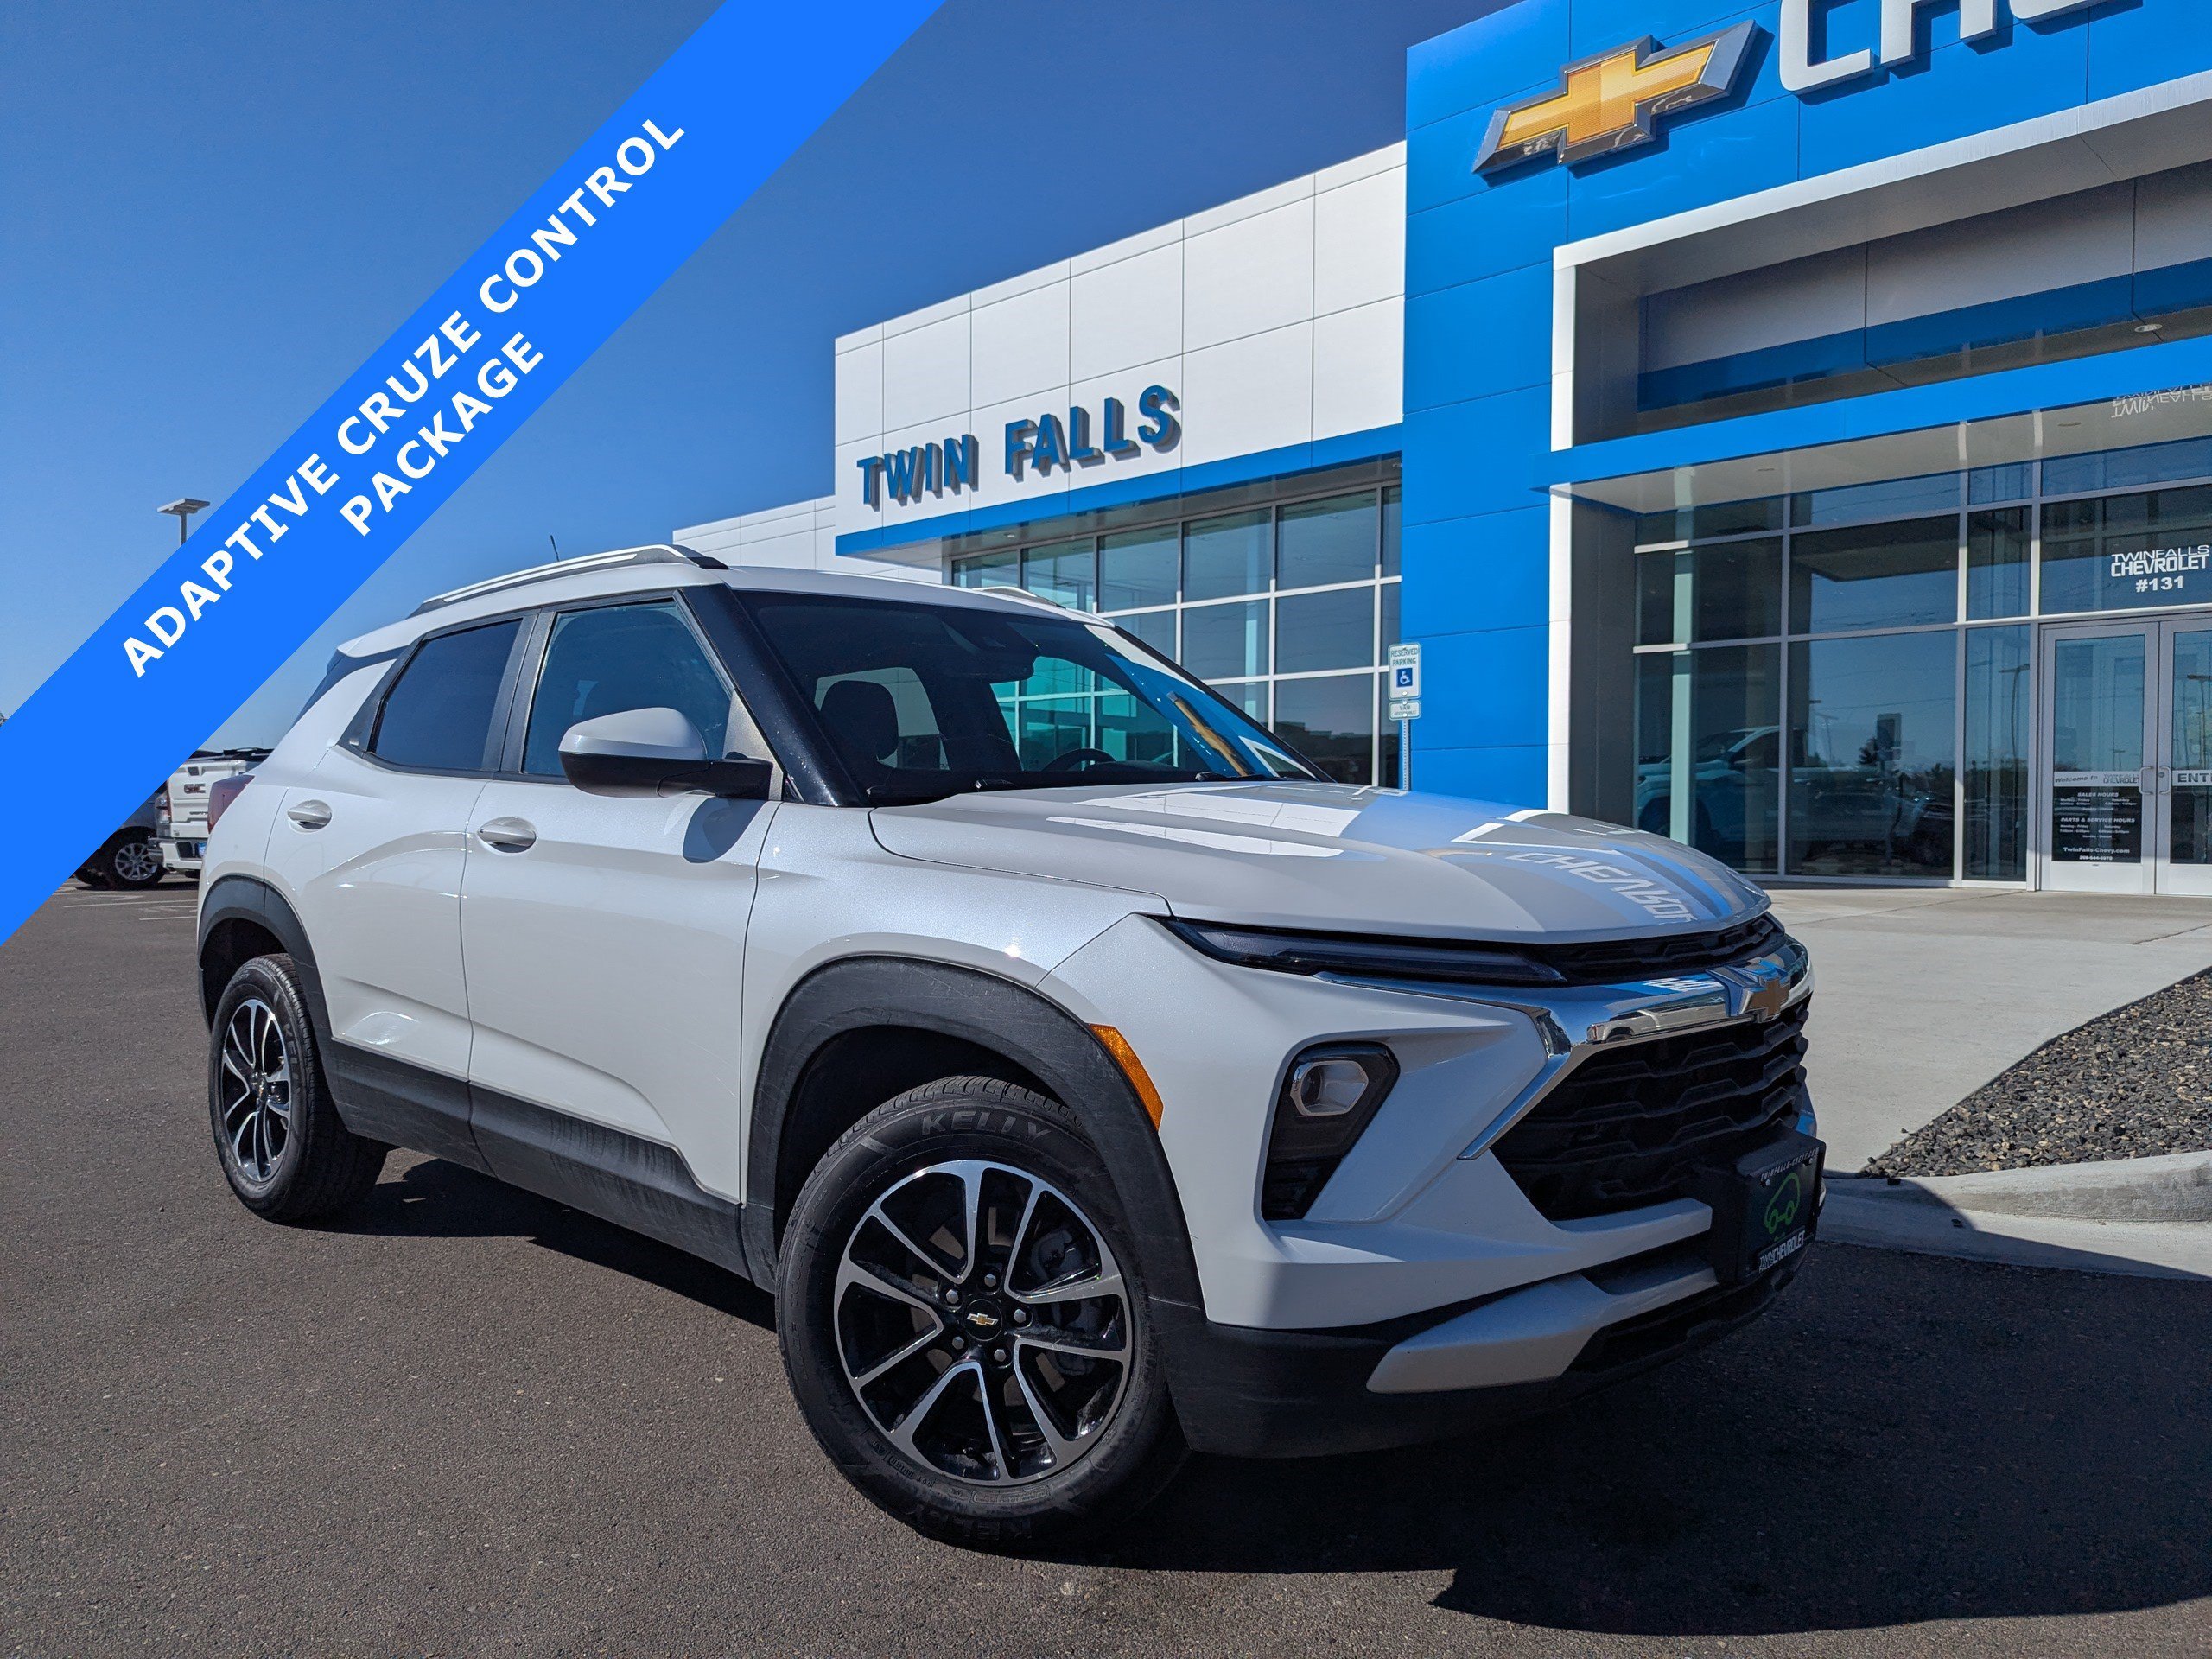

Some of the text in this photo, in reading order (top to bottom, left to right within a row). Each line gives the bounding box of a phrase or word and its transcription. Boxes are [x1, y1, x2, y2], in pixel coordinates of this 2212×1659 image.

[857, 385, 1180, 511] TWIN FALLS
[2111, 544, 2209, 563] TWINFALLS
[2111, 554, 2209, 577] CHEVROLET
[2135, 575, 2183, 593] #131
[1391, 647, 1418, 657] RESERVED
[1393, 658, 1416, 666] PARKING
[184, 783, 206, 794] GMC
[922, 1110, 1052, 1143] KELLY
[1771, 1230, 1806, 1264] CHEVROLET
